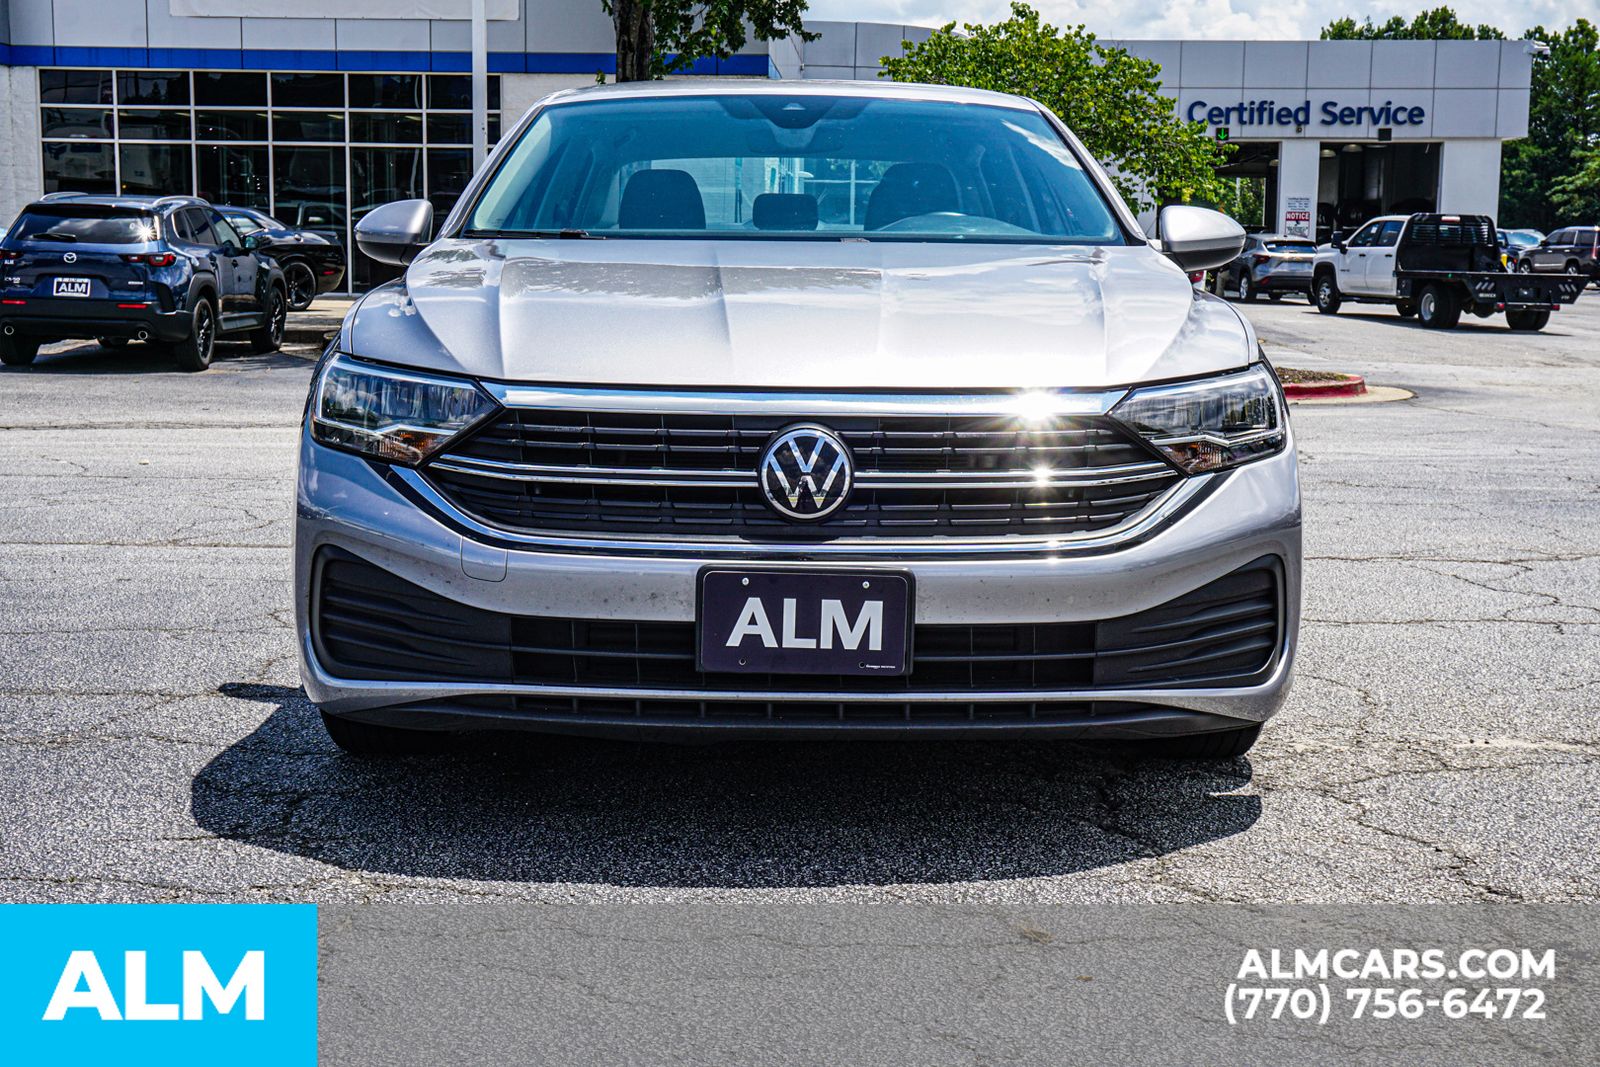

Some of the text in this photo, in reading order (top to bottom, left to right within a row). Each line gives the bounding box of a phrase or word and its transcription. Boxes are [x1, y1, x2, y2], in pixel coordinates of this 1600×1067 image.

[1187, 100, 1425, 126] Certified Service
[1286, 212, 1310, 220] NOTICE
[58, 282, 87, 293] ALM
[725, 596, 884, 651] ALM
